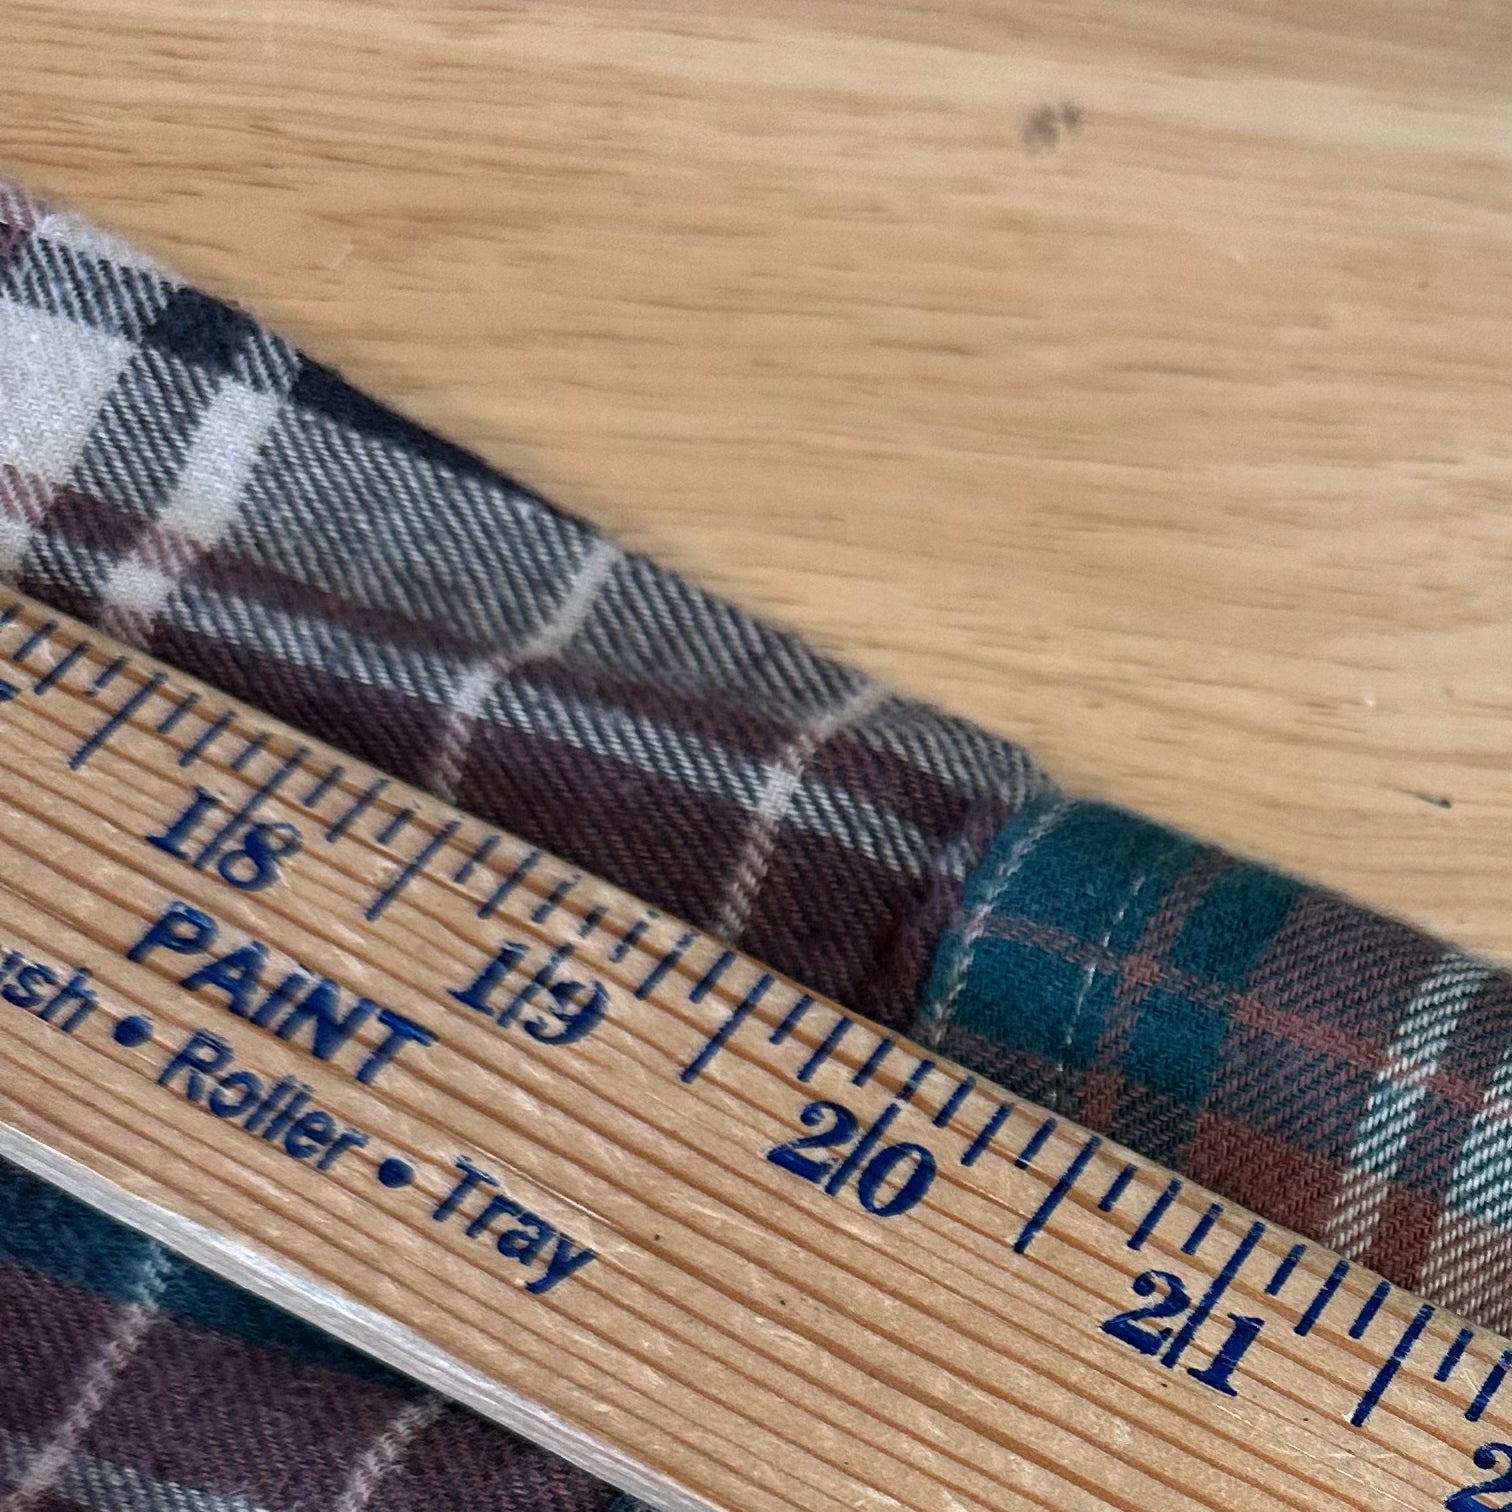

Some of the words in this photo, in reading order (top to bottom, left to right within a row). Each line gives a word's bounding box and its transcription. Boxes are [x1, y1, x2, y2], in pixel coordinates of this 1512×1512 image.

[147, 786, 301, 891] 18
[126, 900, 439, 1084] PAINT
[450, 941, 608, 1045] 19
[0, 948, 99, 1033] sh
[155, 1029, 371, 1172] Roller
[433, 1155, 599, 1295] Tray
[766, 1100, 936, 1217] 20
[1101, 1270, 1264, 1397] 21
